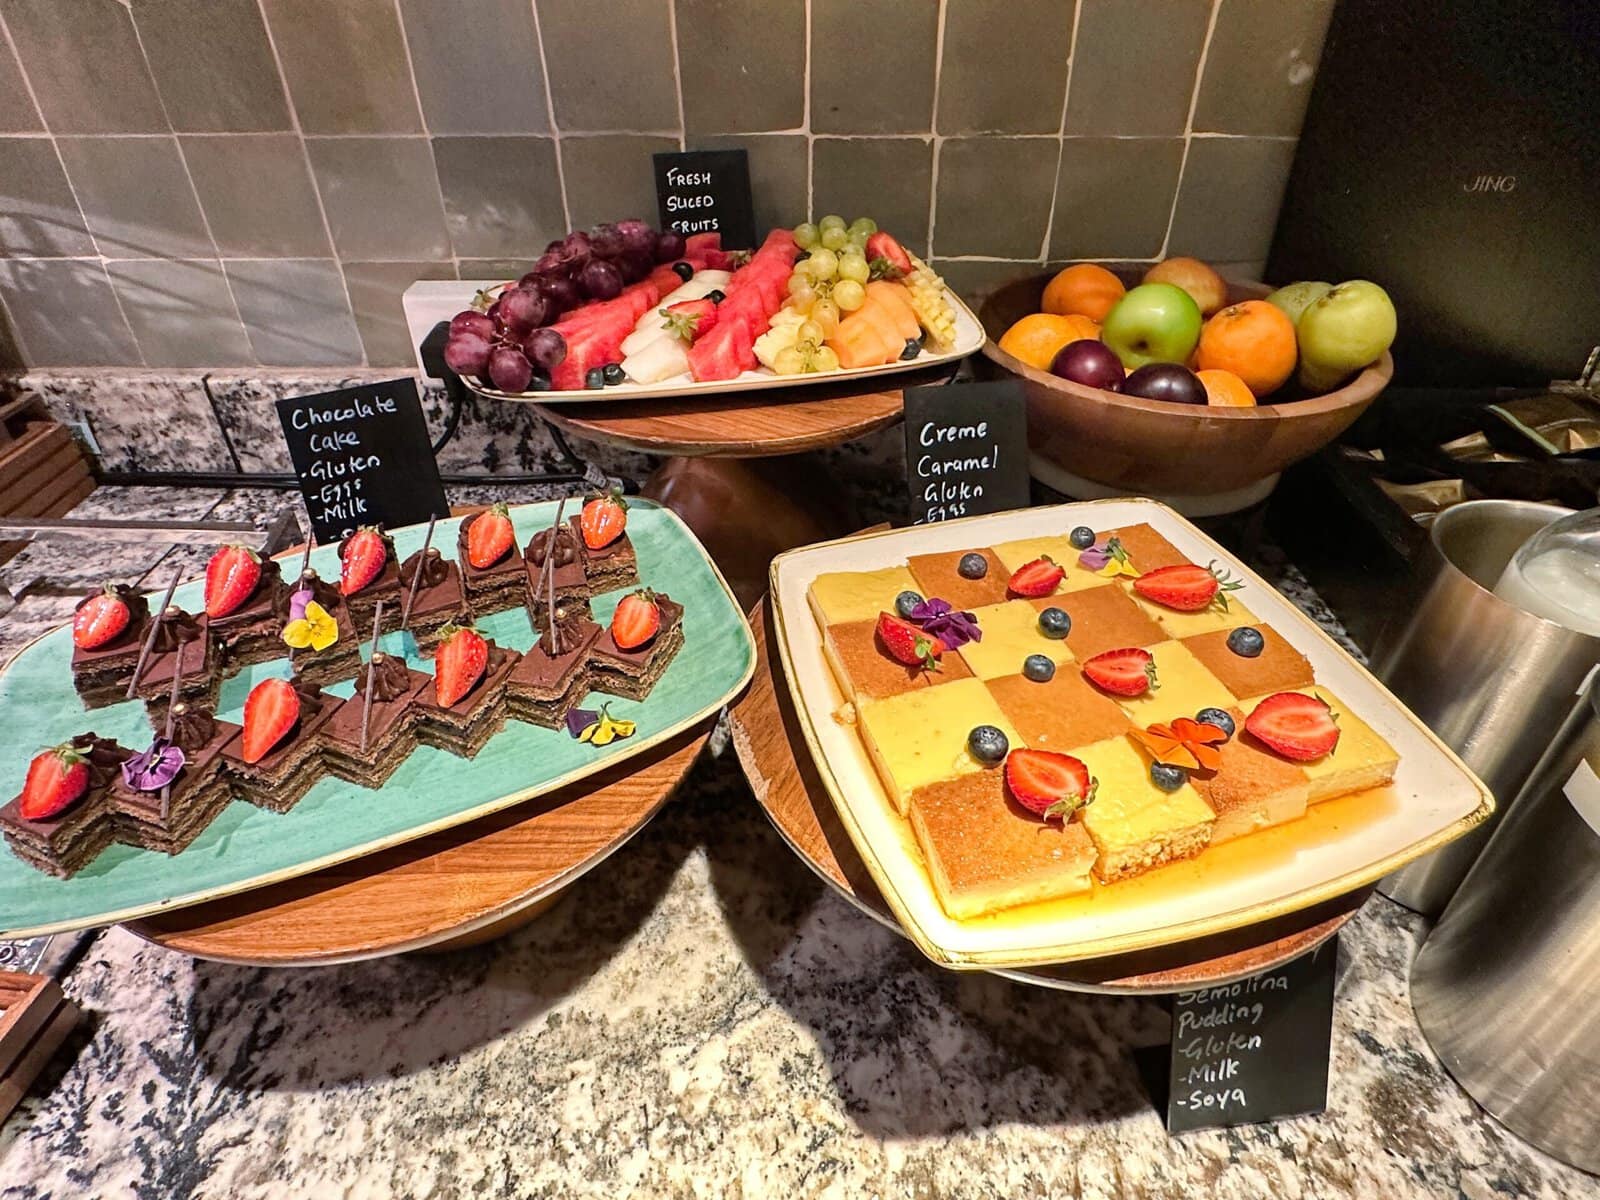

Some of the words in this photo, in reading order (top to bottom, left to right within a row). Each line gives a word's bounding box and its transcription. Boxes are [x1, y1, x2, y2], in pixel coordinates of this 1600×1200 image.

[666, 167, 711, 186] FRESH
[1463, 175, 1516, 192] JING
[666, 195, 714, 212] SLICED
[292, 396, 398, 430] Chocolate
[310, 431, 361, 453] Cake
[919, 422, 988, 446] Creme
[917, 444, 998, 477] Caramel
[1178, 1002, 1264, 1038] Pudding
[1178, 1058, 1240, 1084] -Milk
